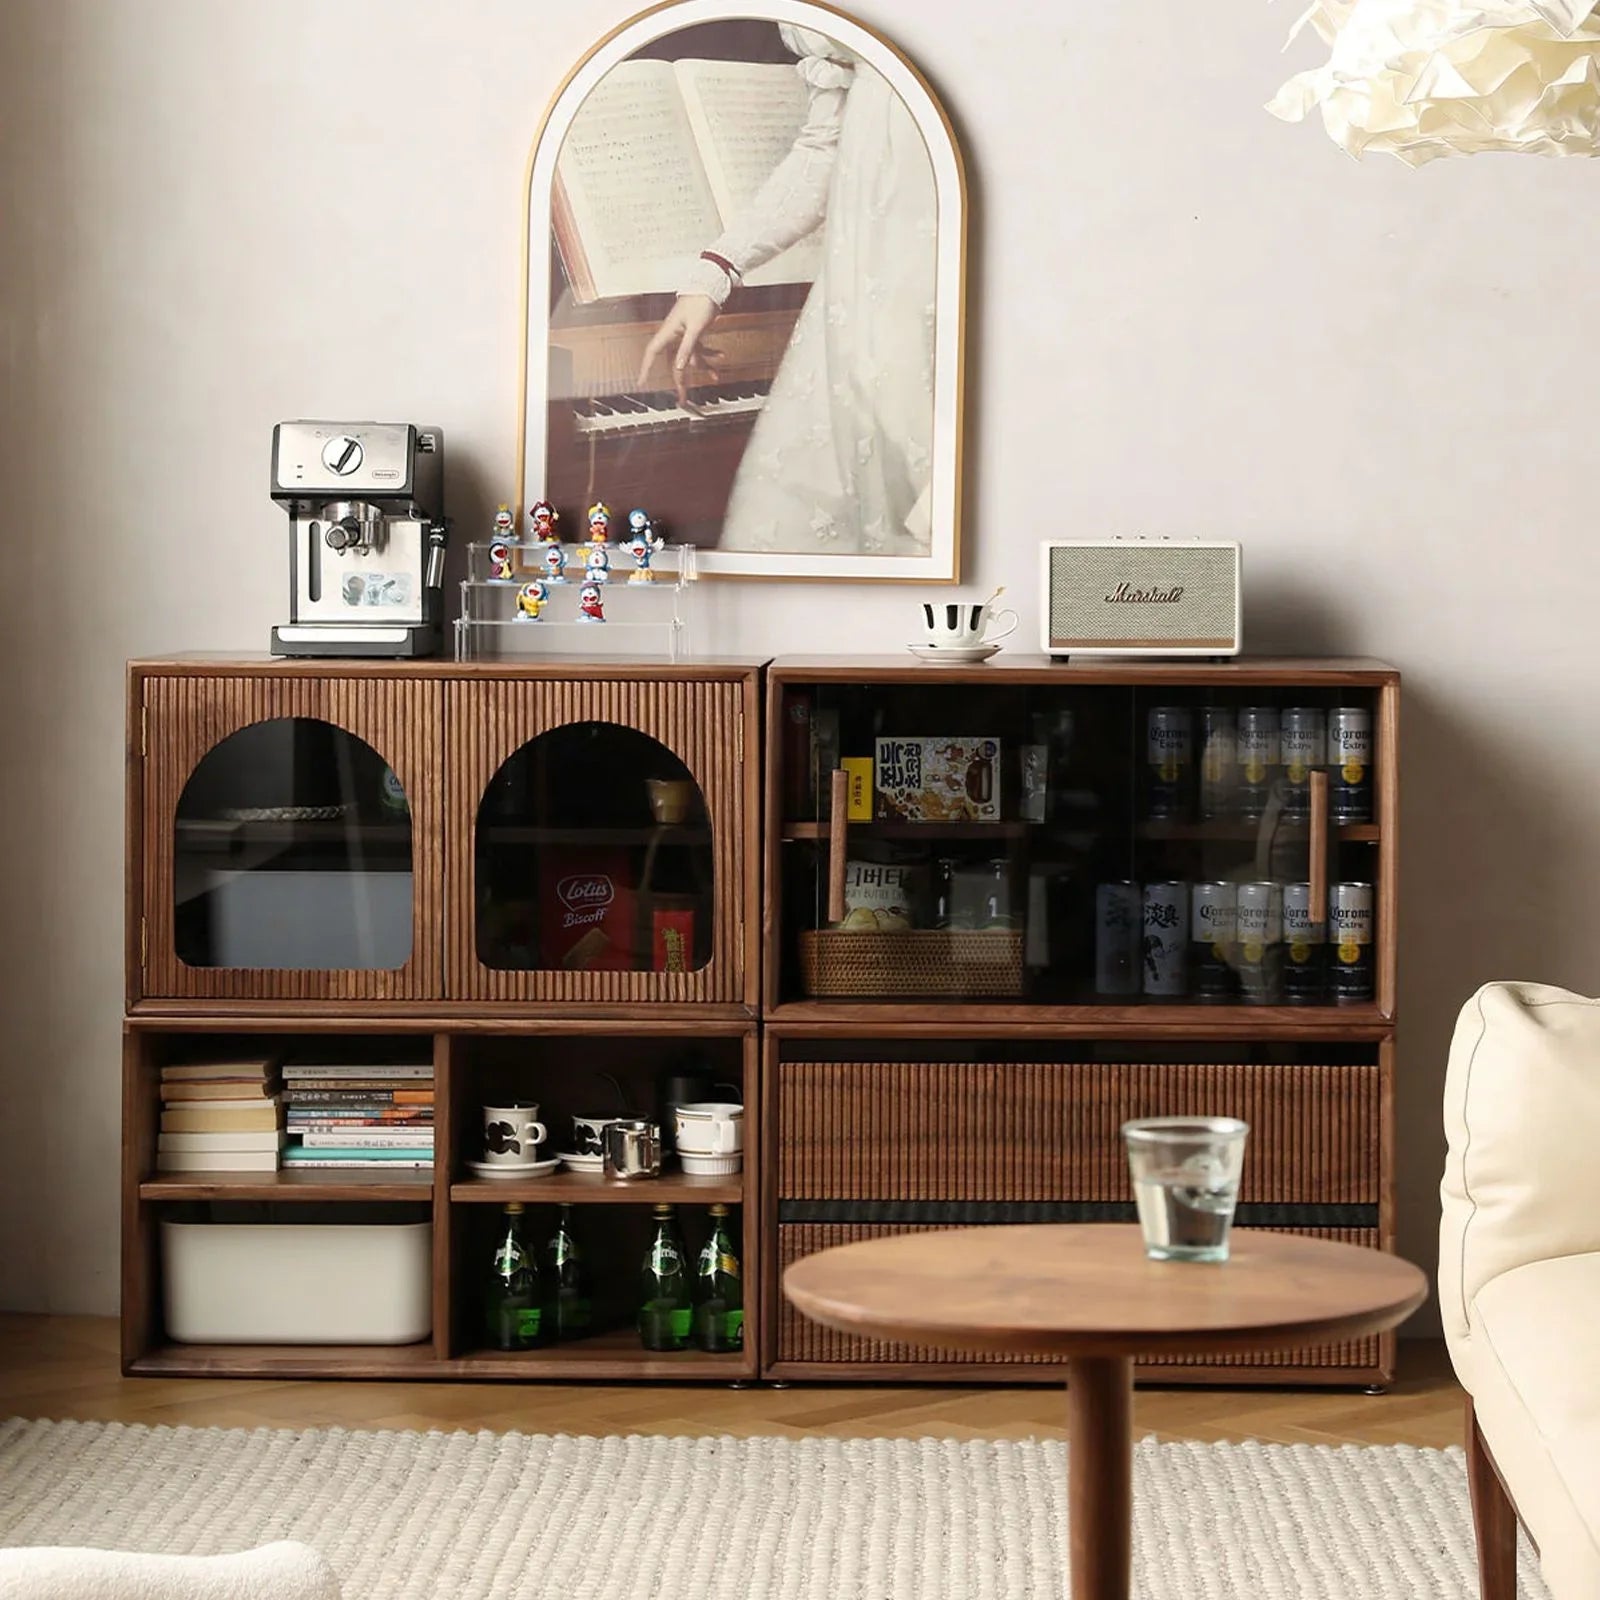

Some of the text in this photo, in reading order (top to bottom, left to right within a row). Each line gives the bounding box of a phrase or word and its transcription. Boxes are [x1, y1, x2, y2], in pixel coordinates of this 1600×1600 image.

[1103, 582, 1184, 603] Marshall
[566, 880, 608, 900] Lotus
[562, 907, 608, 928] Biscoff
[1338, 919, 1364, 929] Extra
